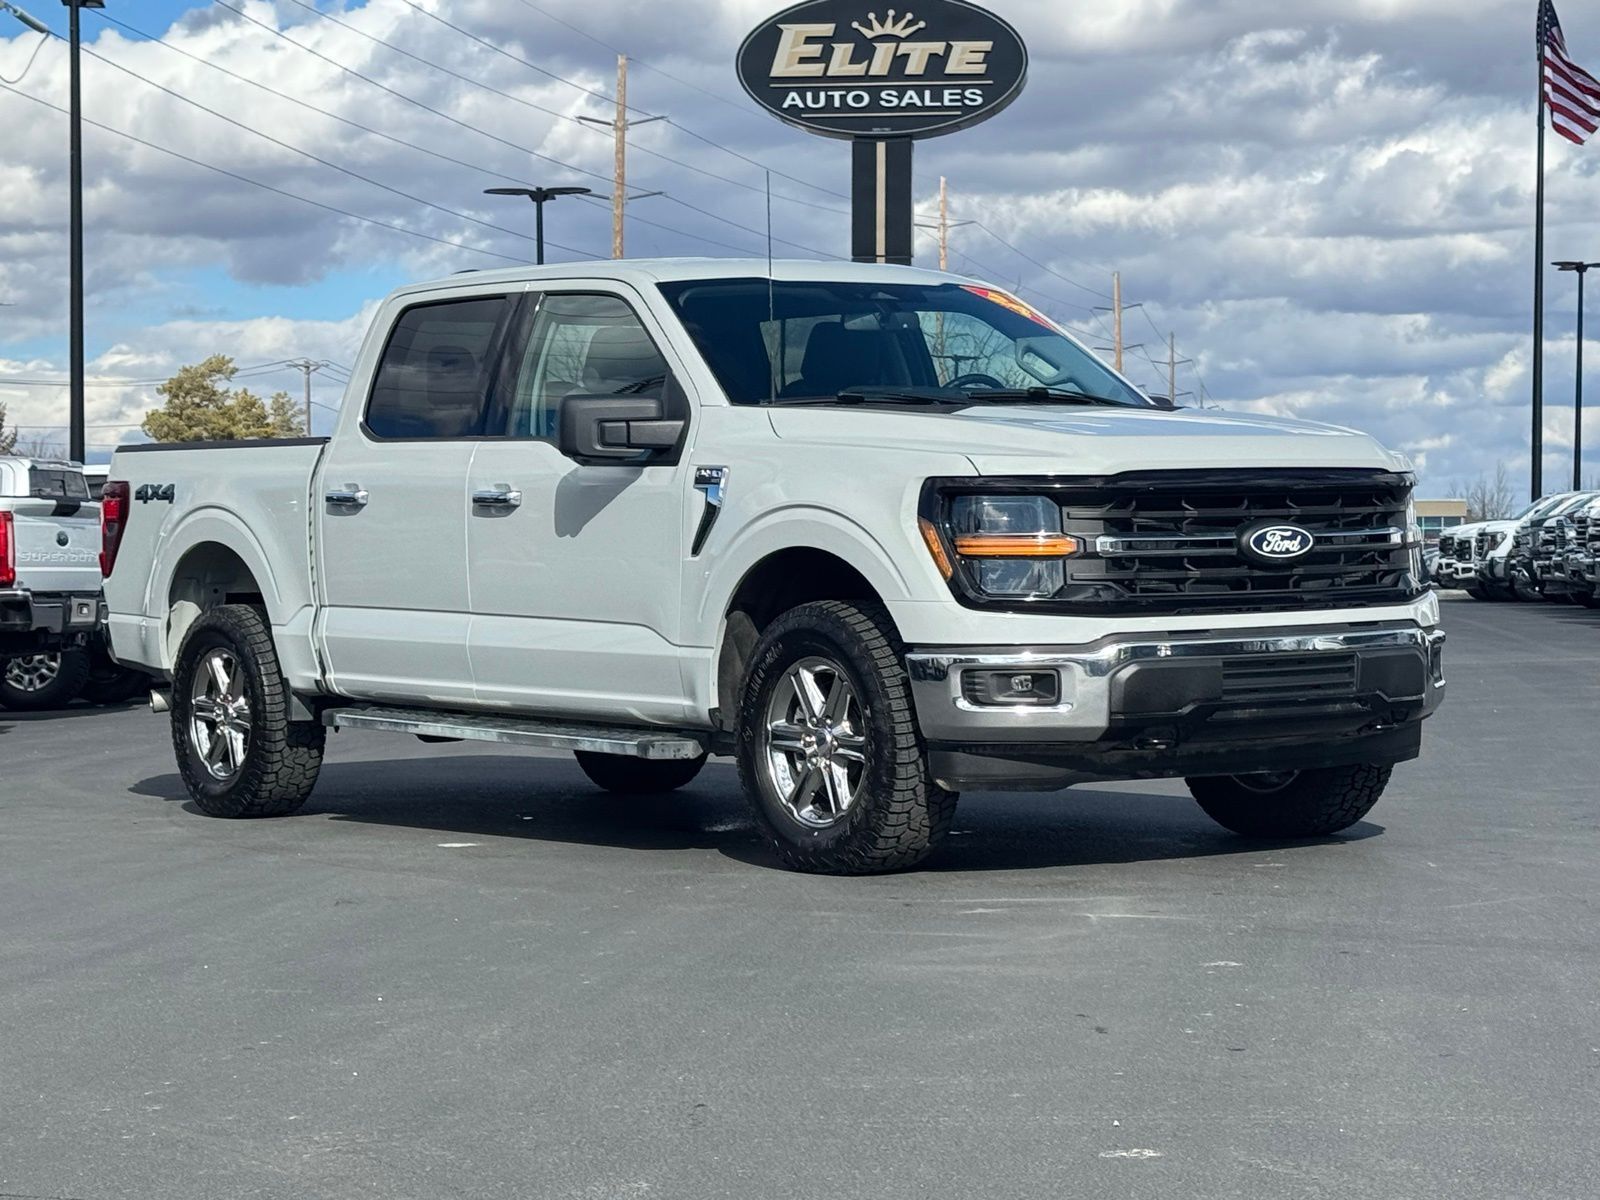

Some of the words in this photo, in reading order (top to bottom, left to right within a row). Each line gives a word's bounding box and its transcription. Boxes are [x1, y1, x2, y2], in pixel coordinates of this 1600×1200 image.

[769, 23, 994, 78] ELITE
[781, 90, 870, 109] AUTO
[879, 88, 984, 107] SALES
[1262, 530, 1302, 553] Ford
